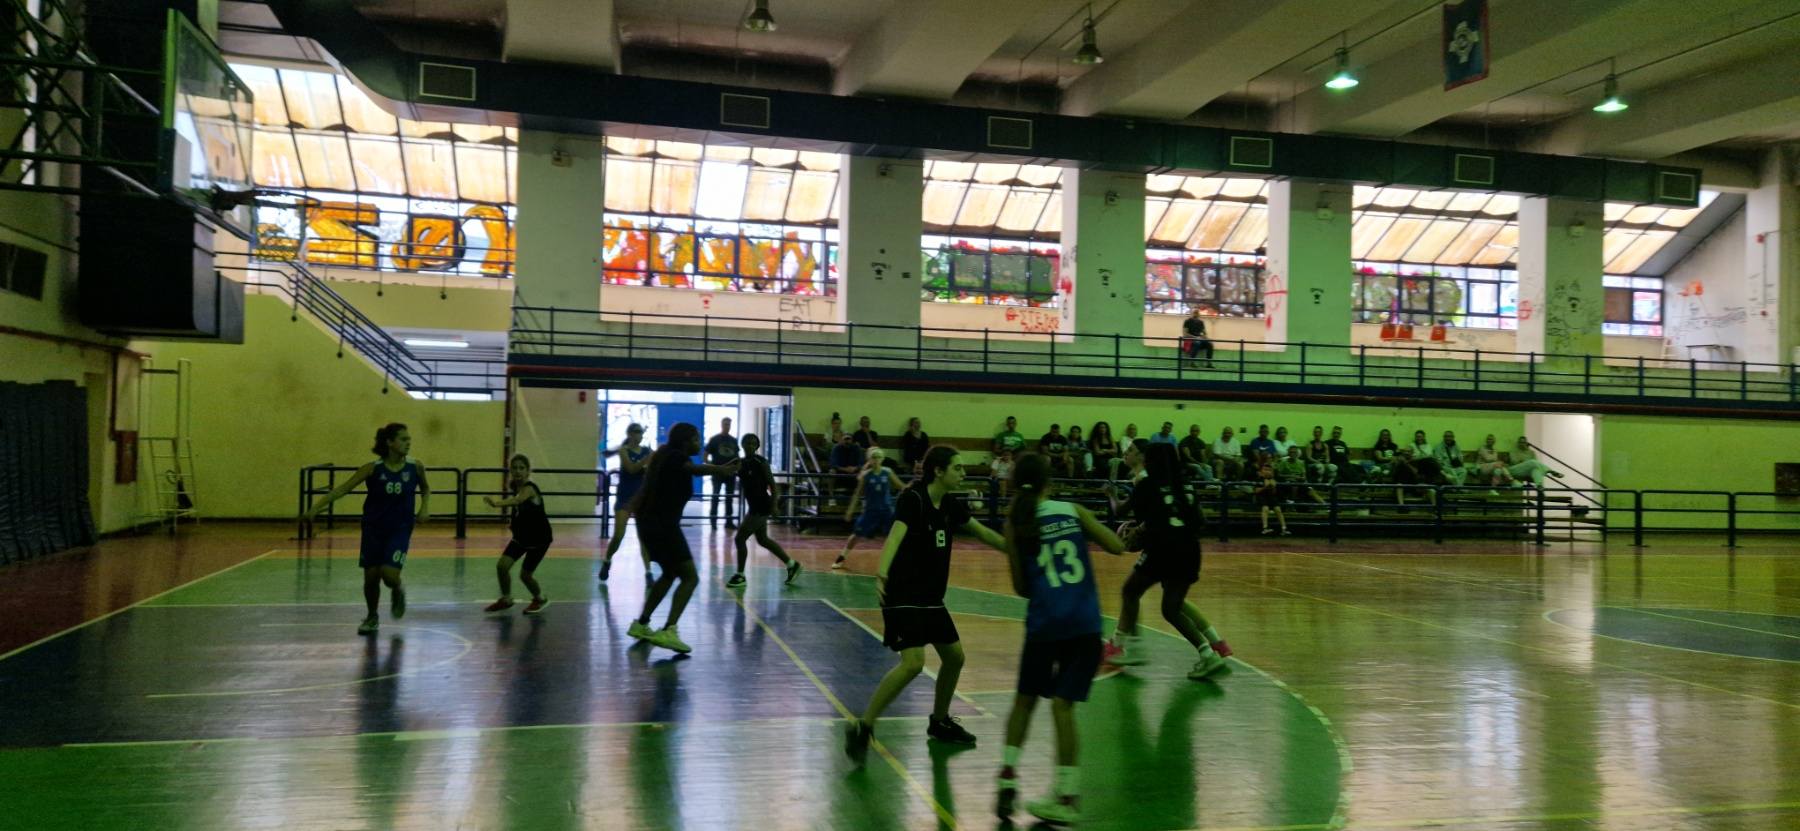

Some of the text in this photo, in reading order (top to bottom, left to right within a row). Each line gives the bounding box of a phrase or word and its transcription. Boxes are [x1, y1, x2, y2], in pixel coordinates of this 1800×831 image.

[779, 296, 814, 317] EAT
[385, 481, 402, 495] 68
[1036, 540, 1086, 587] 13
